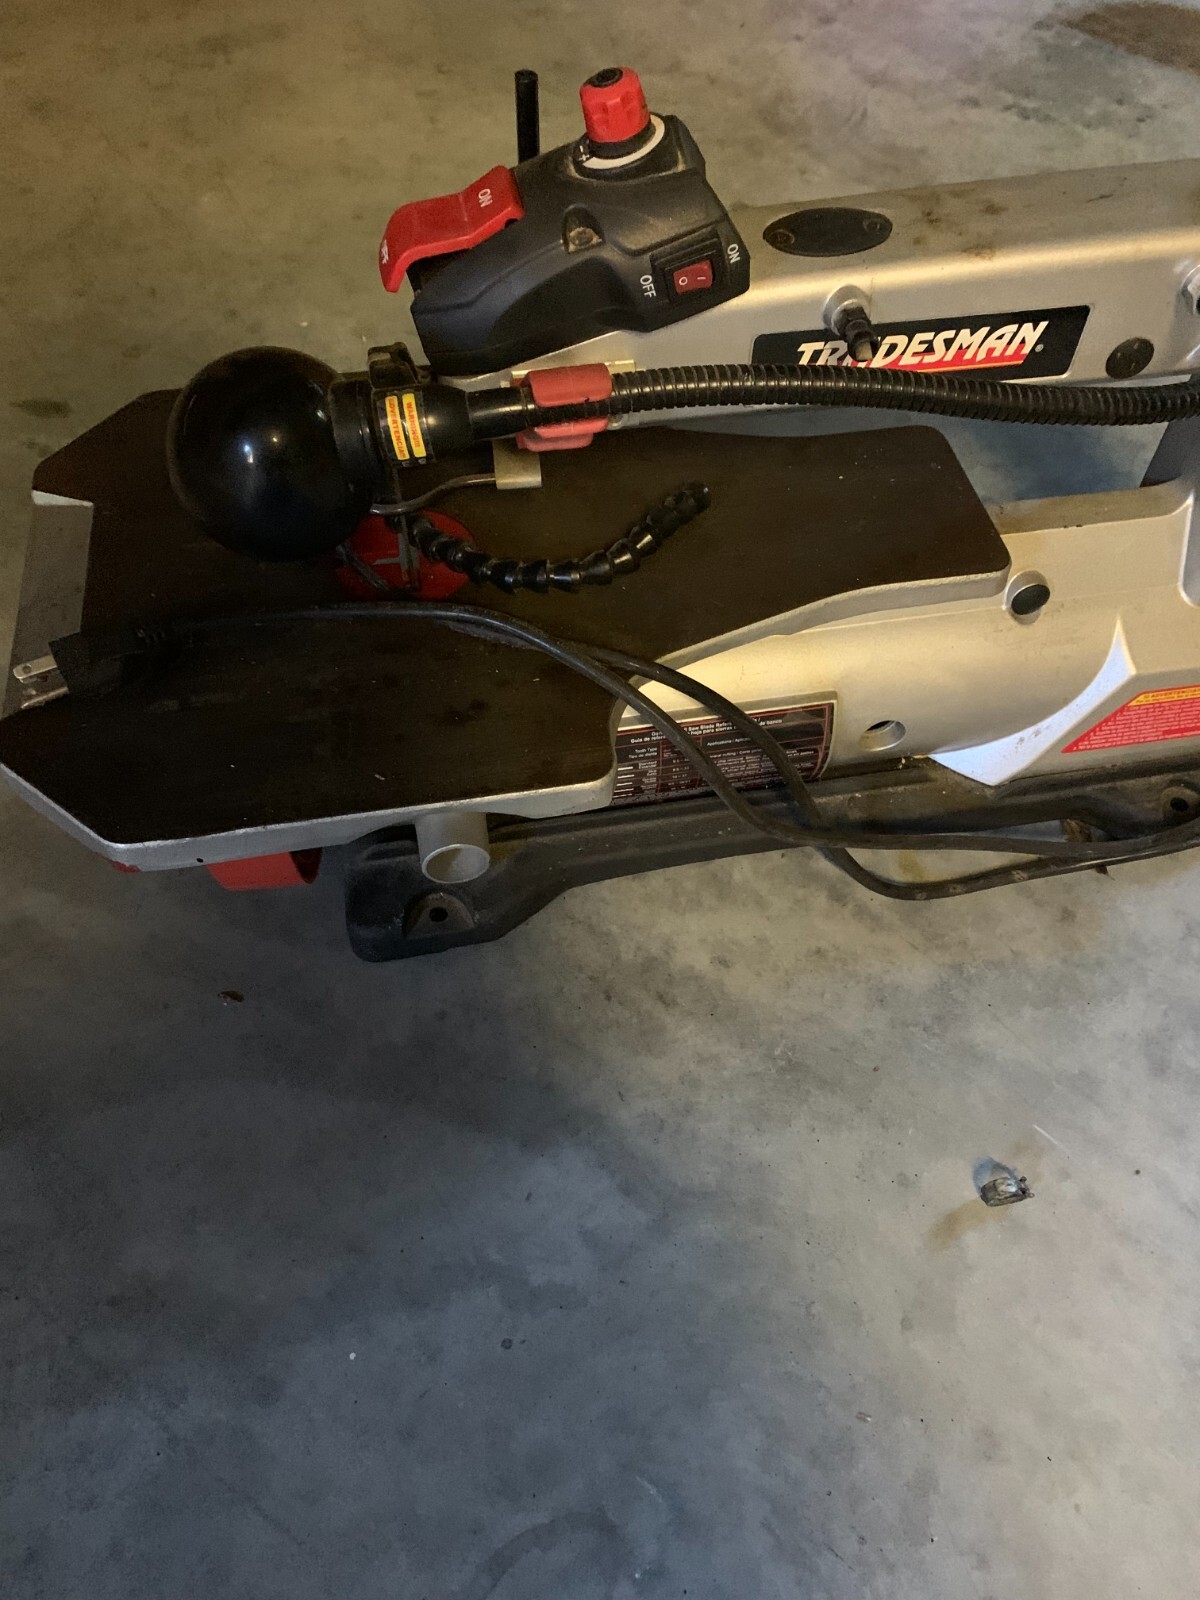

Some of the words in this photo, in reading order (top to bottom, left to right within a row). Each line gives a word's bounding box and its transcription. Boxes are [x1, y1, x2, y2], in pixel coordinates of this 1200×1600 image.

[478, 188, 493, 208] ON
[727, 243, 741, 264] ON
[640, 274, 657, 298] OFF
